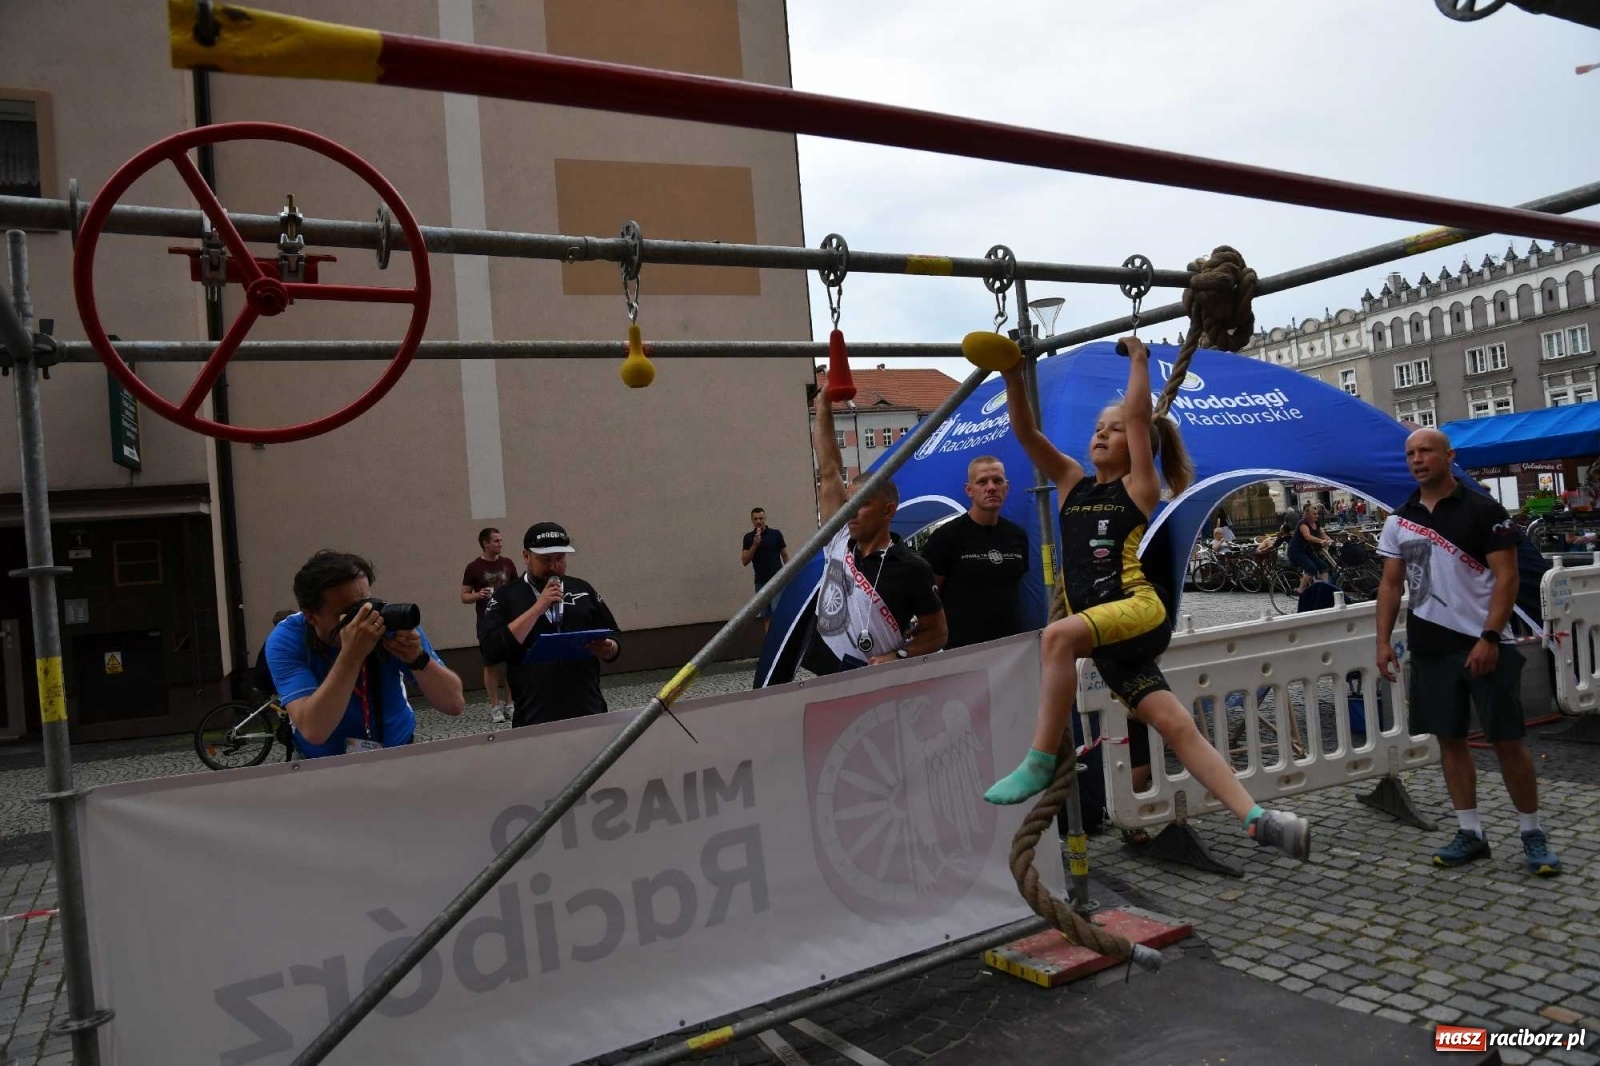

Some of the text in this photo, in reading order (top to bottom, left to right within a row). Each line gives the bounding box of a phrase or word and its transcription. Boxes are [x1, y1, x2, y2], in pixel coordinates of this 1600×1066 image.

[1172, 388, 1290, 409] Wodociągi
[1184, 406, 1304, 426] Raciborskie
[938, 425, 1010, 453] Raciborskie
[1522, 462, 1555, 471] Gelateria
